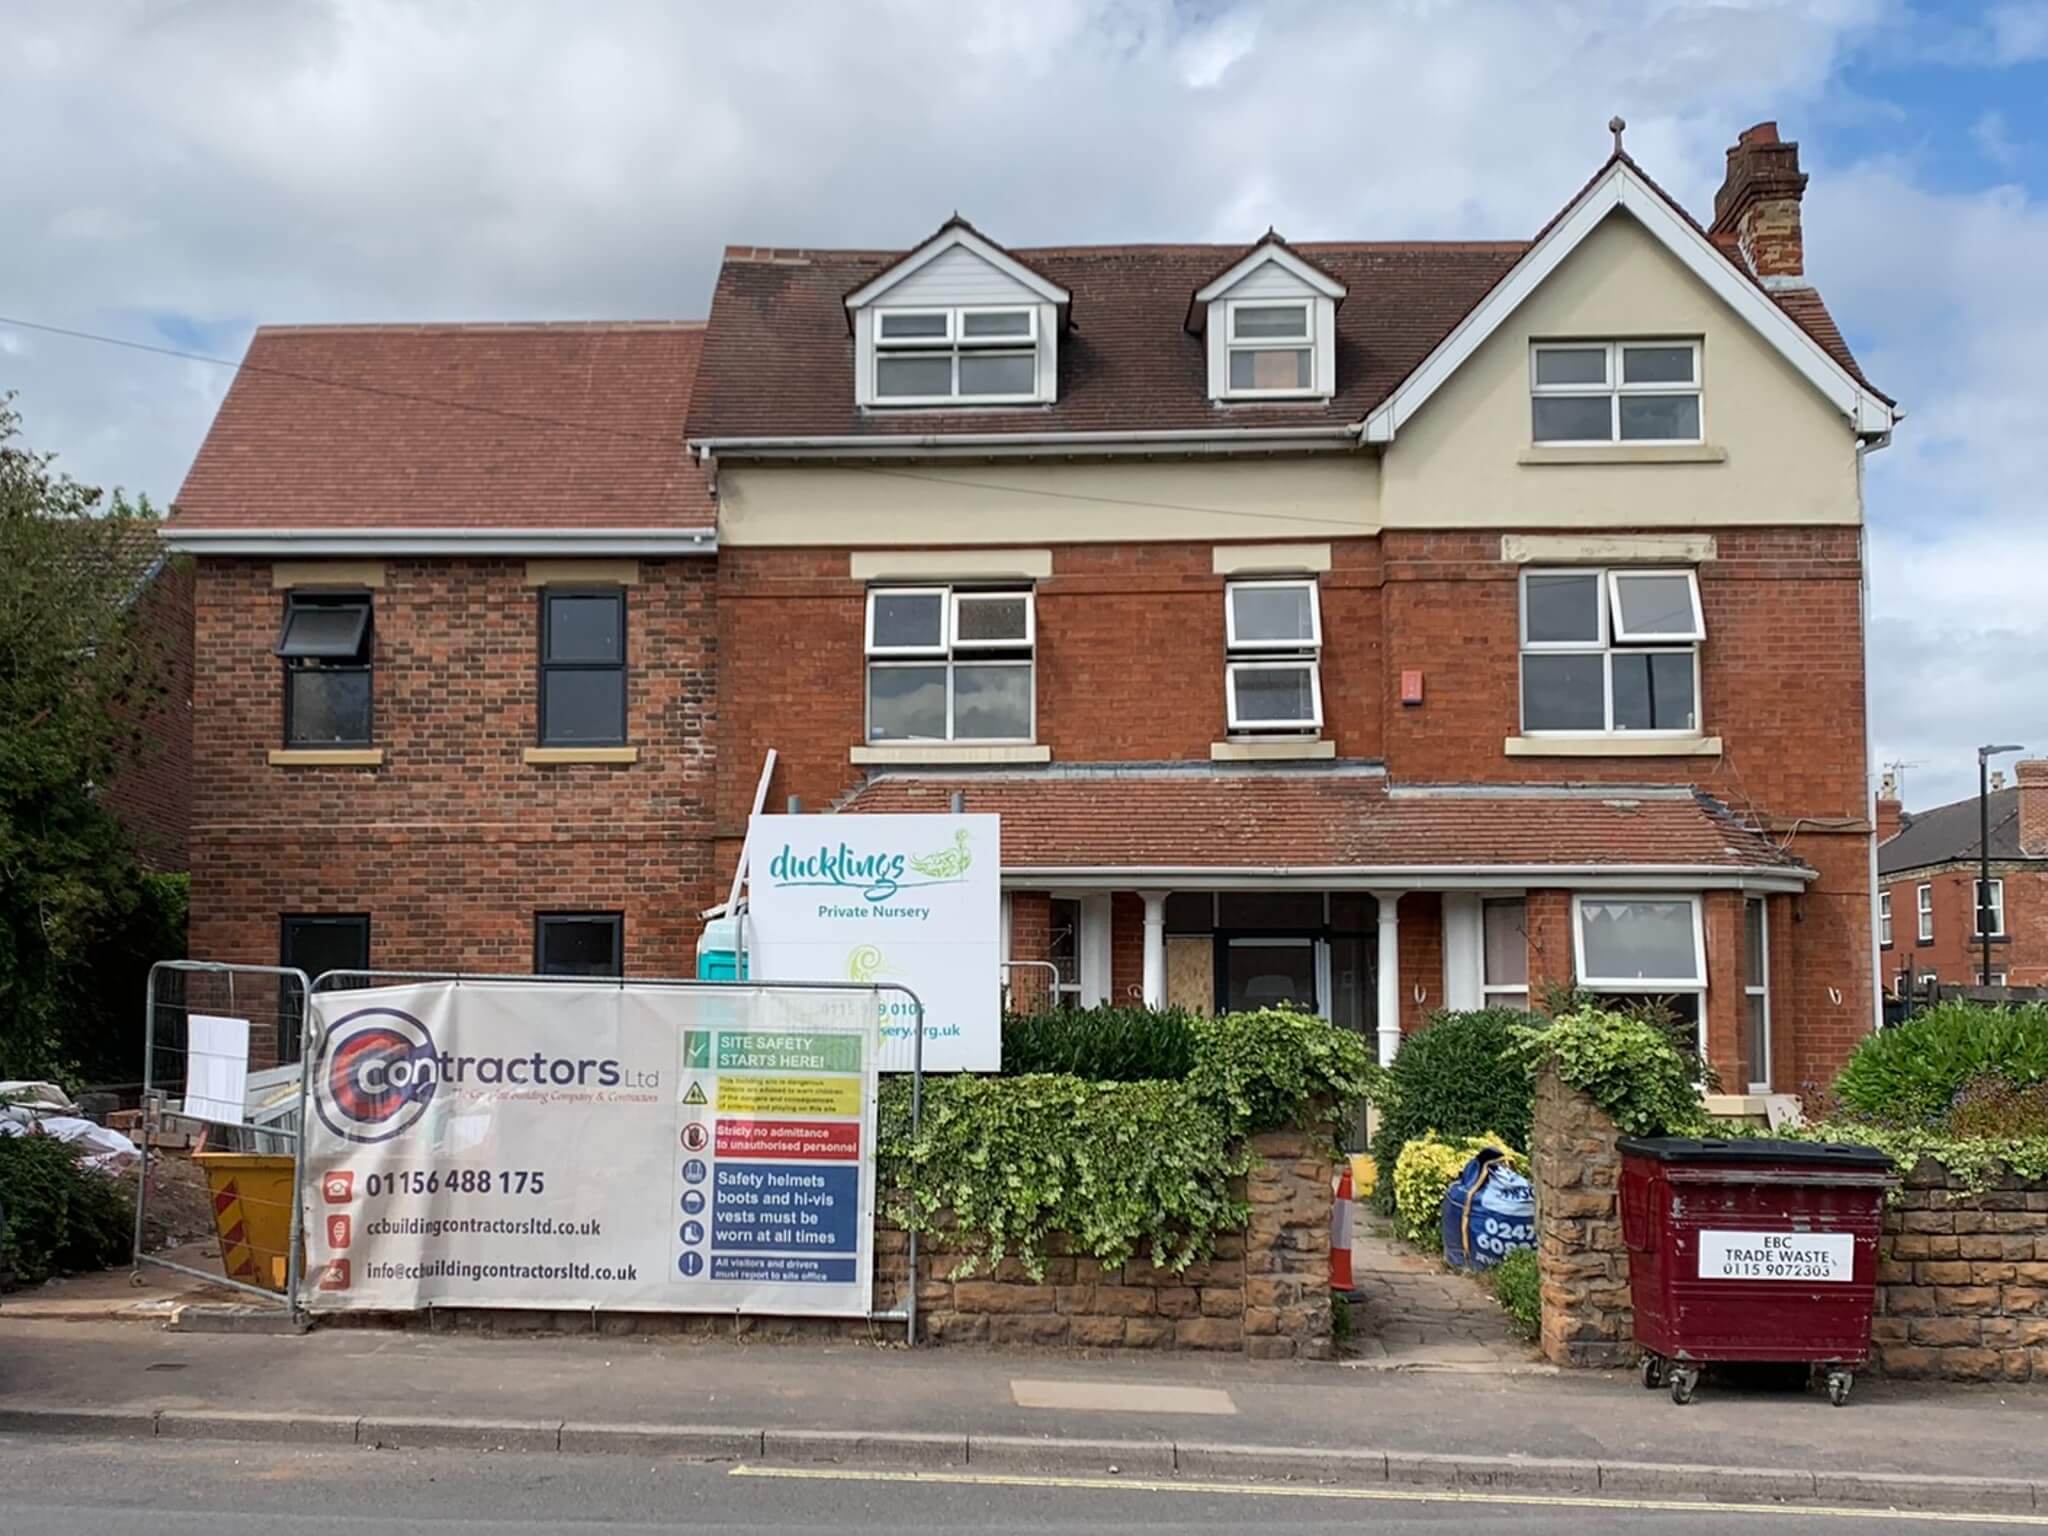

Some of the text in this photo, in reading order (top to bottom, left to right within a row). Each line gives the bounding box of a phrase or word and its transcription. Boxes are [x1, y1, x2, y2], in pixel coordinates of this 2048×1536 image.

[770, 842, 905, 902] ducklings
[818, 905, 930, 920] Private Nursery
[720, 1036, 813, 1050] SITE SAFETY
[719, 1053, 824, 1068] STARTS HERE!
[624, 1069, 660, 1088] Ltd
[753, 1127, 768, 1137] no
[770, 1127, 830, 1138] admittance
[716, 1139, 857, 1153] to unauthorised personnel
[366, 1169, 545, 1197] 01156 488 175
[717, 1172, 826, 1188] Safety helmets
[717, 1190, 834, 1207] boots and hi-vis
[716, 1211, 818, 1225] vests must be
[366, 1217, 601, 1237] ccbuildingcontractorsltd.co.uk
[716, 1229, 836, 1244] worn at all times
[1763, 1236, 1792, 1249] EBC
[1725, 1249, 1829, 1263] TRADE WASTE
[366, 1259, 638, 1281] info@ccbuildingcontractorsltd.co.uk
[715, 1258, 819, 1270] All visitors and drivers
[1723, 1263, 1831, 1277] 0115 9072303
[714, 1271, 828, 1282] must report to site office
